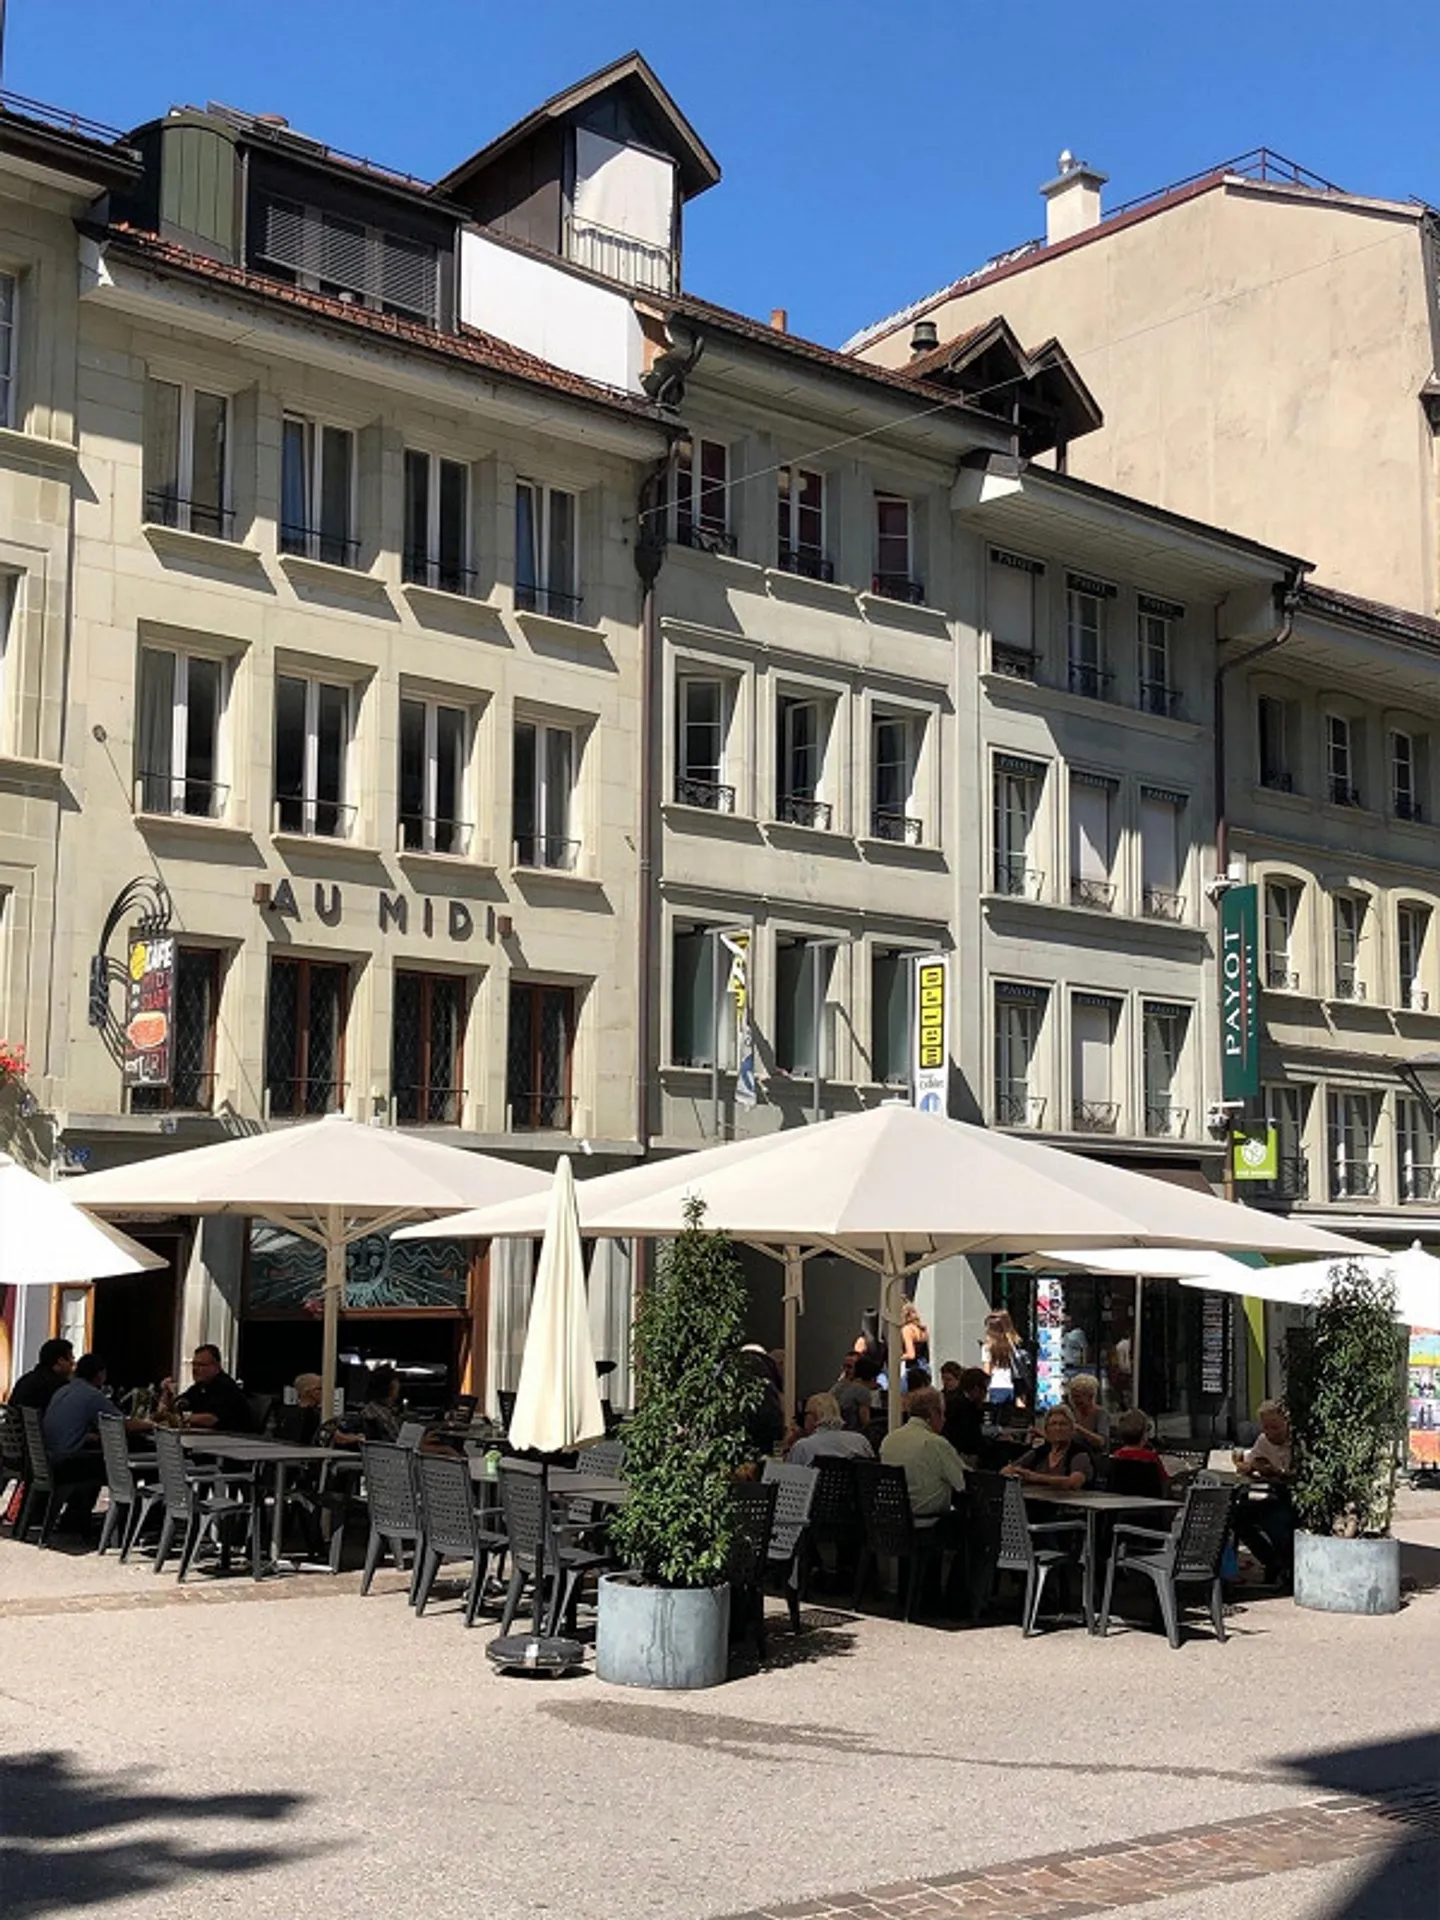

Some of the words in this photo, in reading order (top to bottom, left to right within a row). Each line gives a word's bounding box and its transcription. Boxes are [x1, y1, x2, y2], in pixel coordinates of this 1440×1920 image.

[273, 879, 342, 928] AU
[379, 890, 496, 945] MIDI
[1224, 927, 1242, 1056] PAYOT
